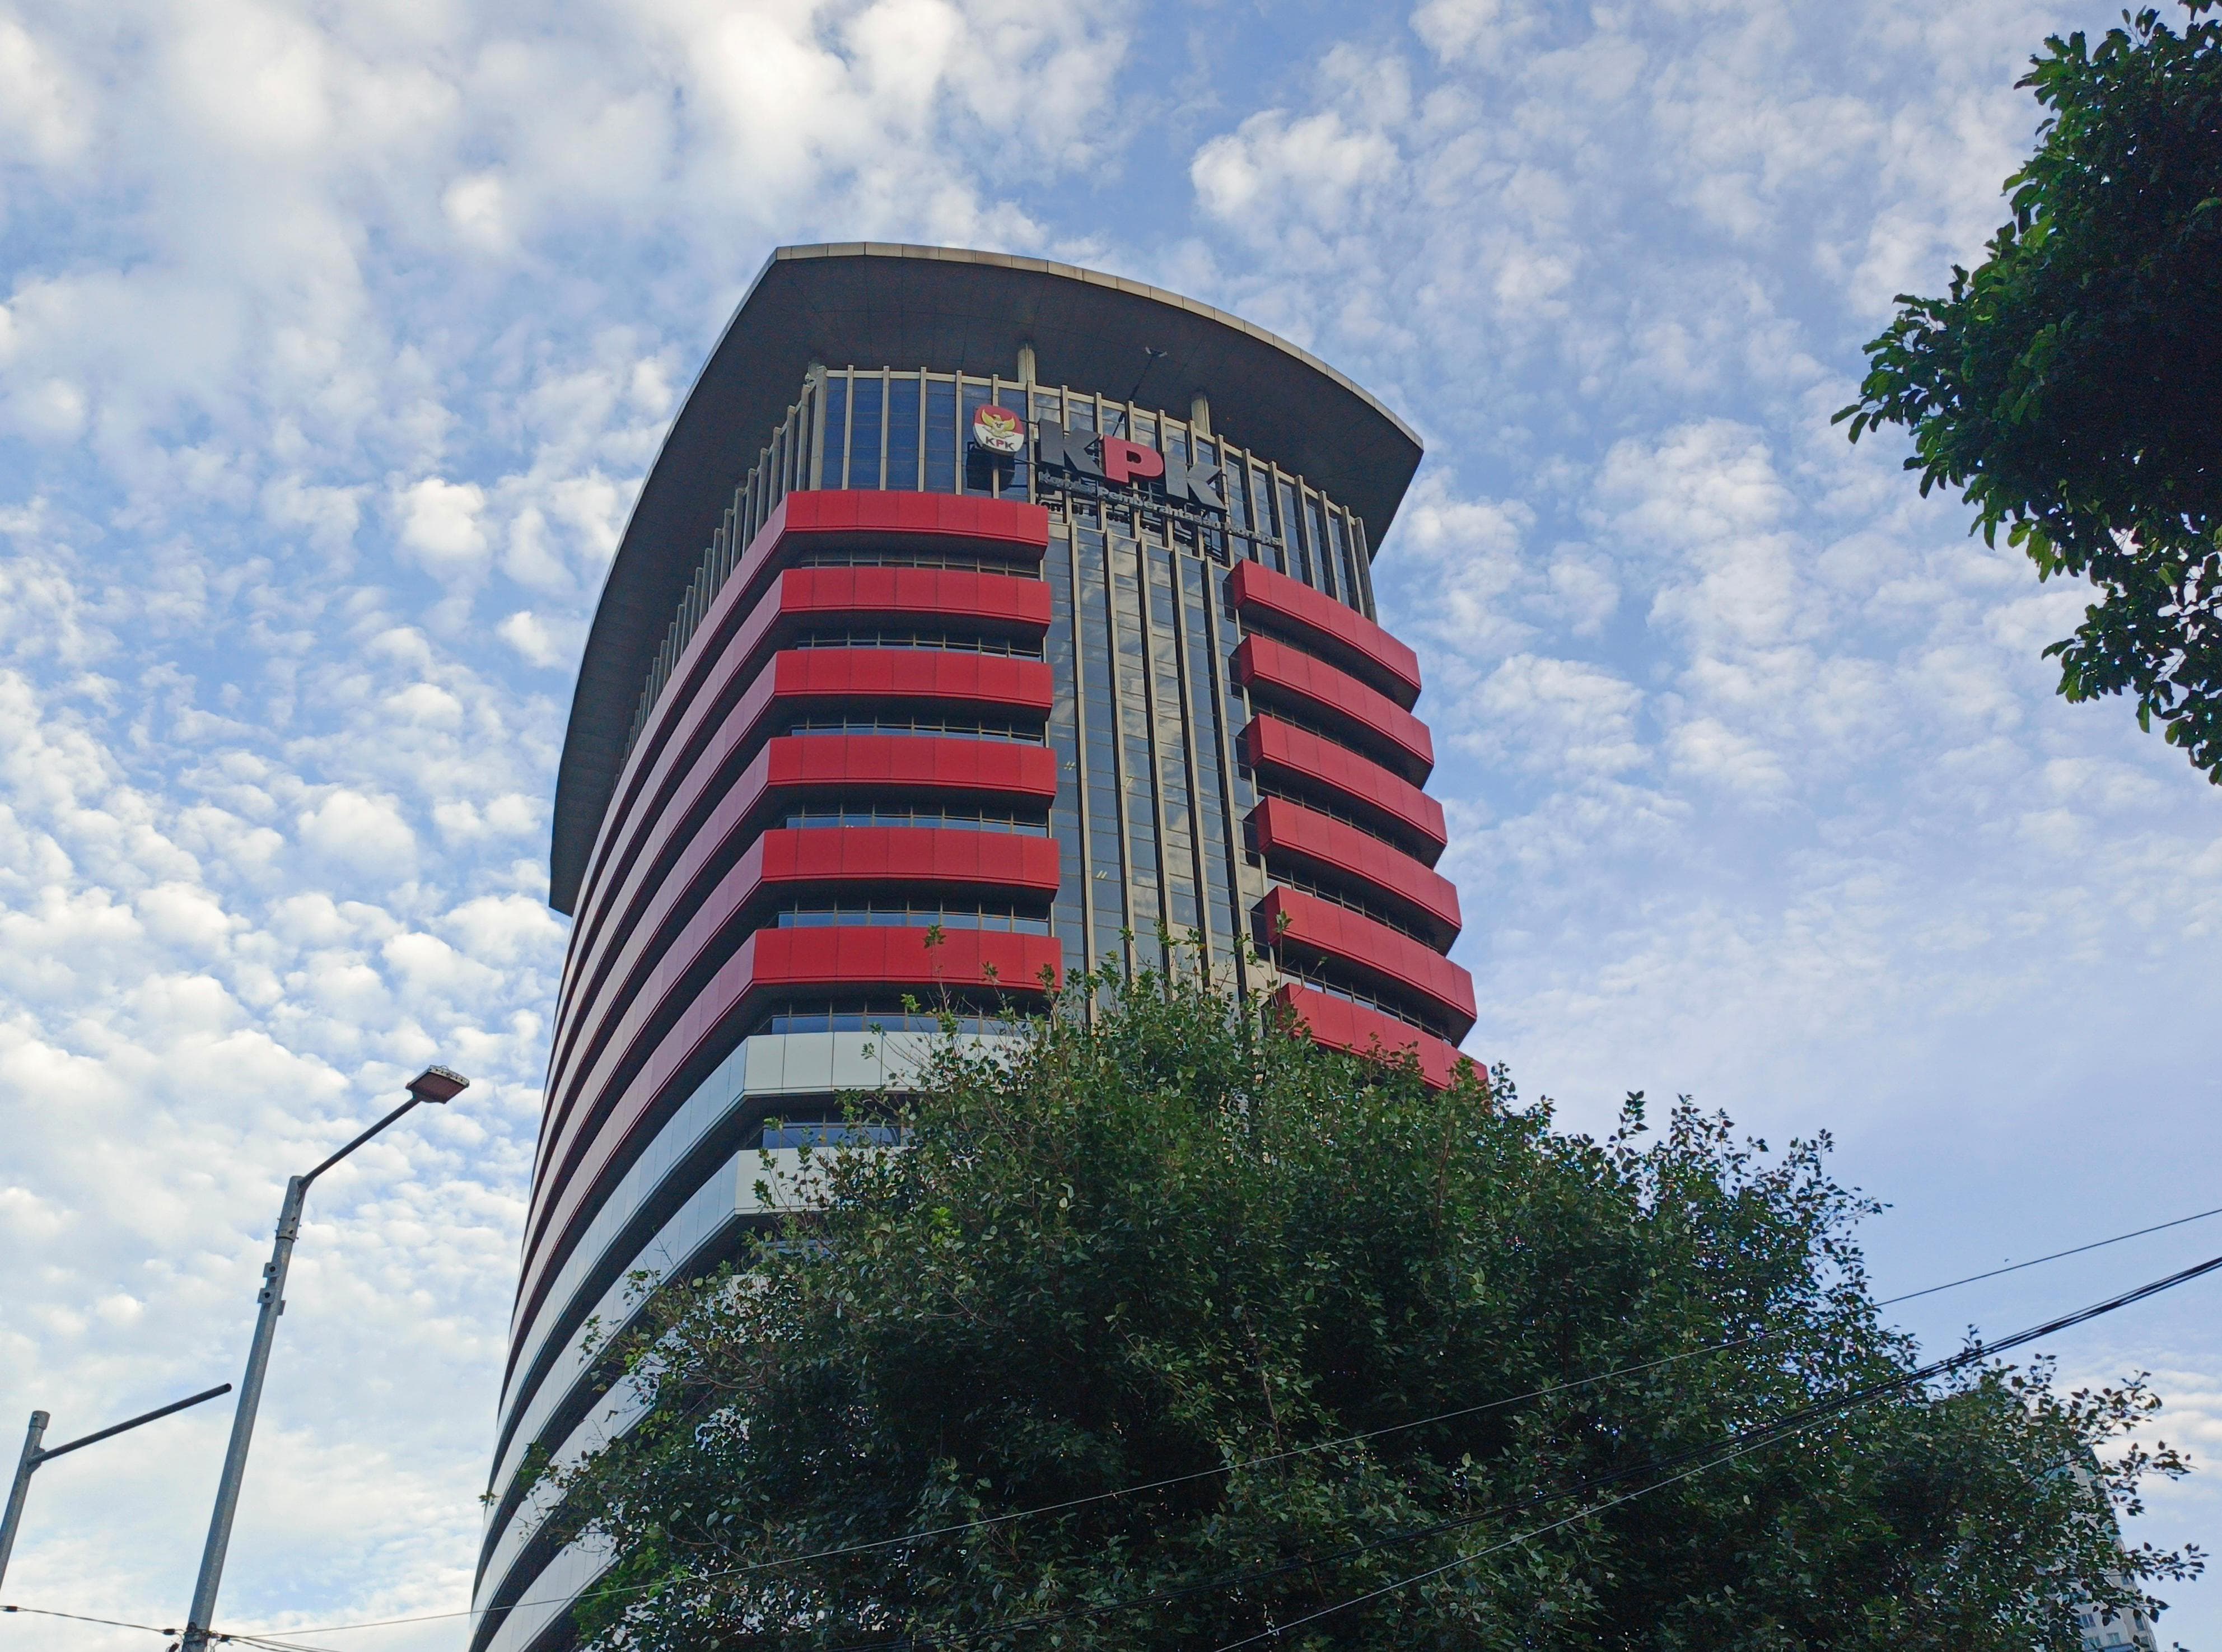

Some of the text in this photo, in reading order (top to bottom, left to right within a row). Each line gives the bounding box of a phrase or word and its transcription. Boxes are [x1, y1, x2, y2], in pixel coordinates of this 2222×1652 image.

[986, 436, 1015, 451] KPK
[1037, 418, 1228, 513] KPK
[1097, 486, 1221, 529] Pemberantasan
